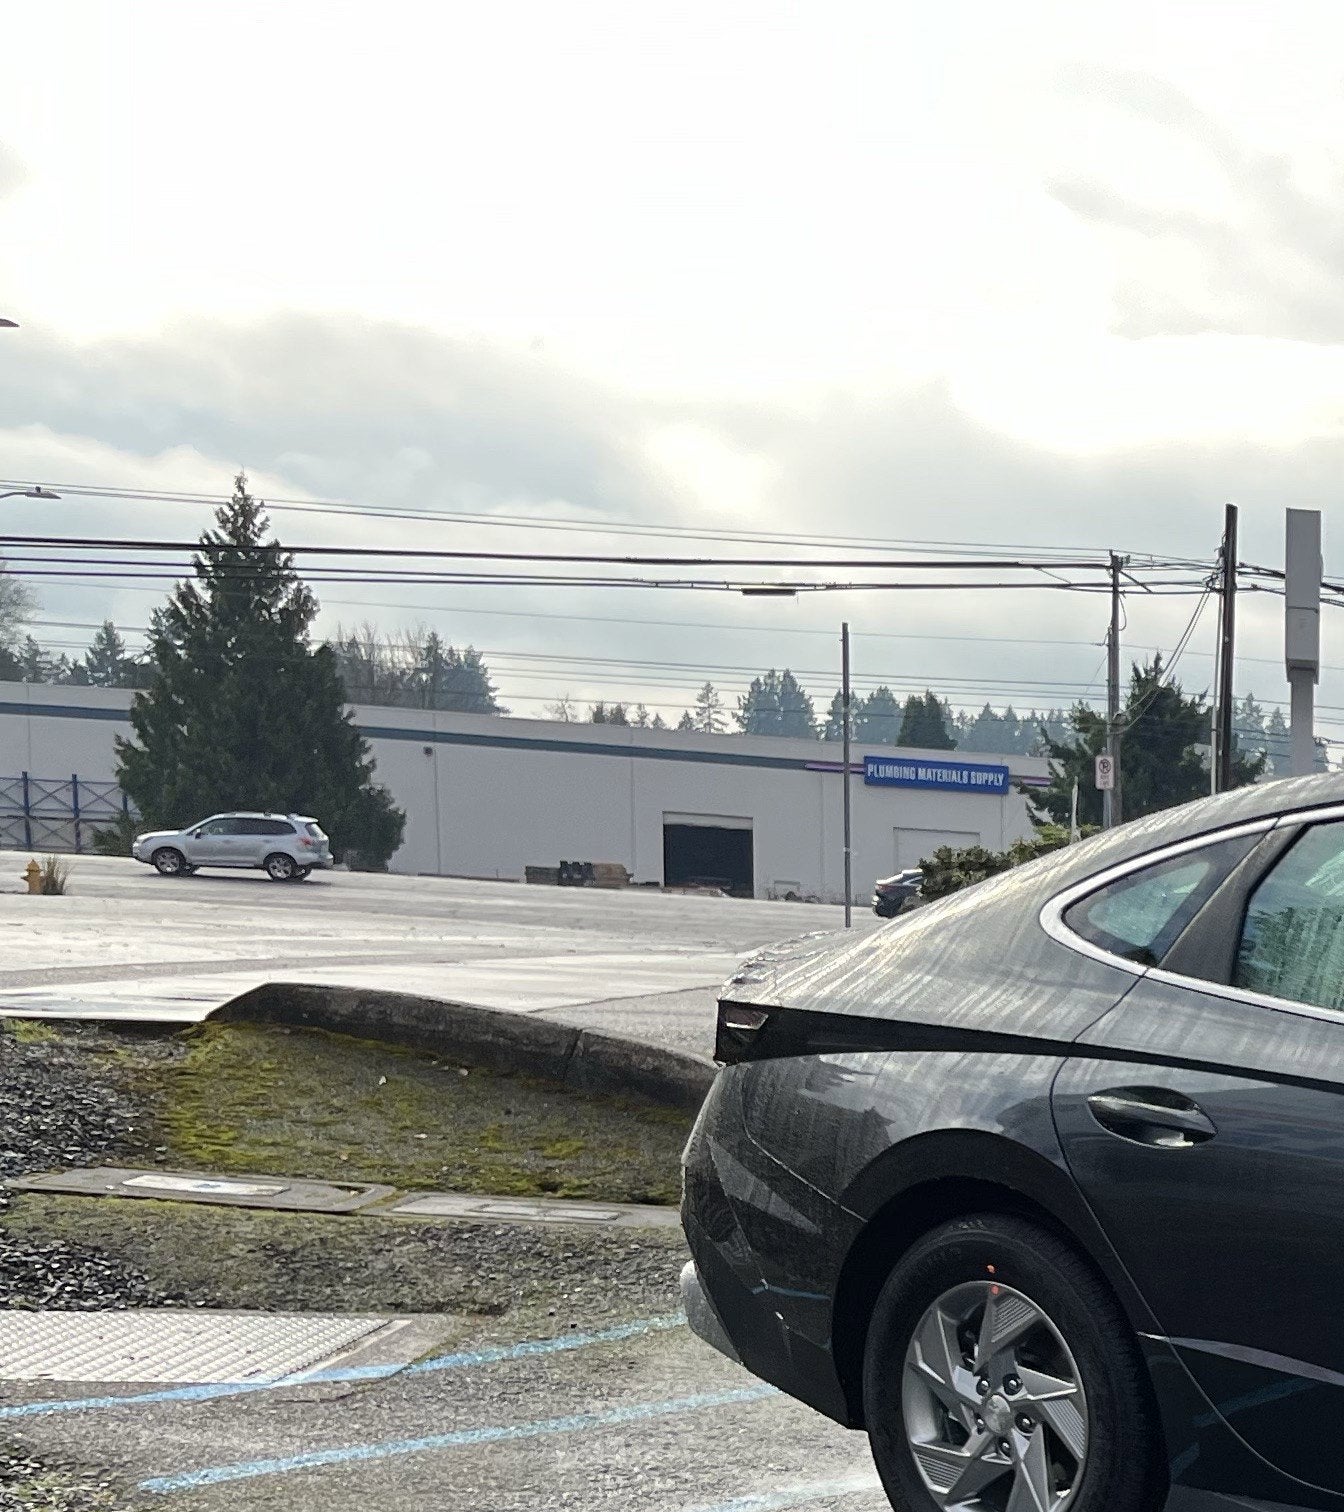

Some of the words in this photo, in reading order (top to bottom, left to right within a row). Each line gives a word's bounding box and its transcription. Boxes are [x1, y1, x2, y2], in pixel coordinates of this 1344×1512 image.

[867, 764, 916, 780] PLUMBING
[918, 768, 968, 784] MATERIALS
[970, 771, 1004, 787] SUPPLY
